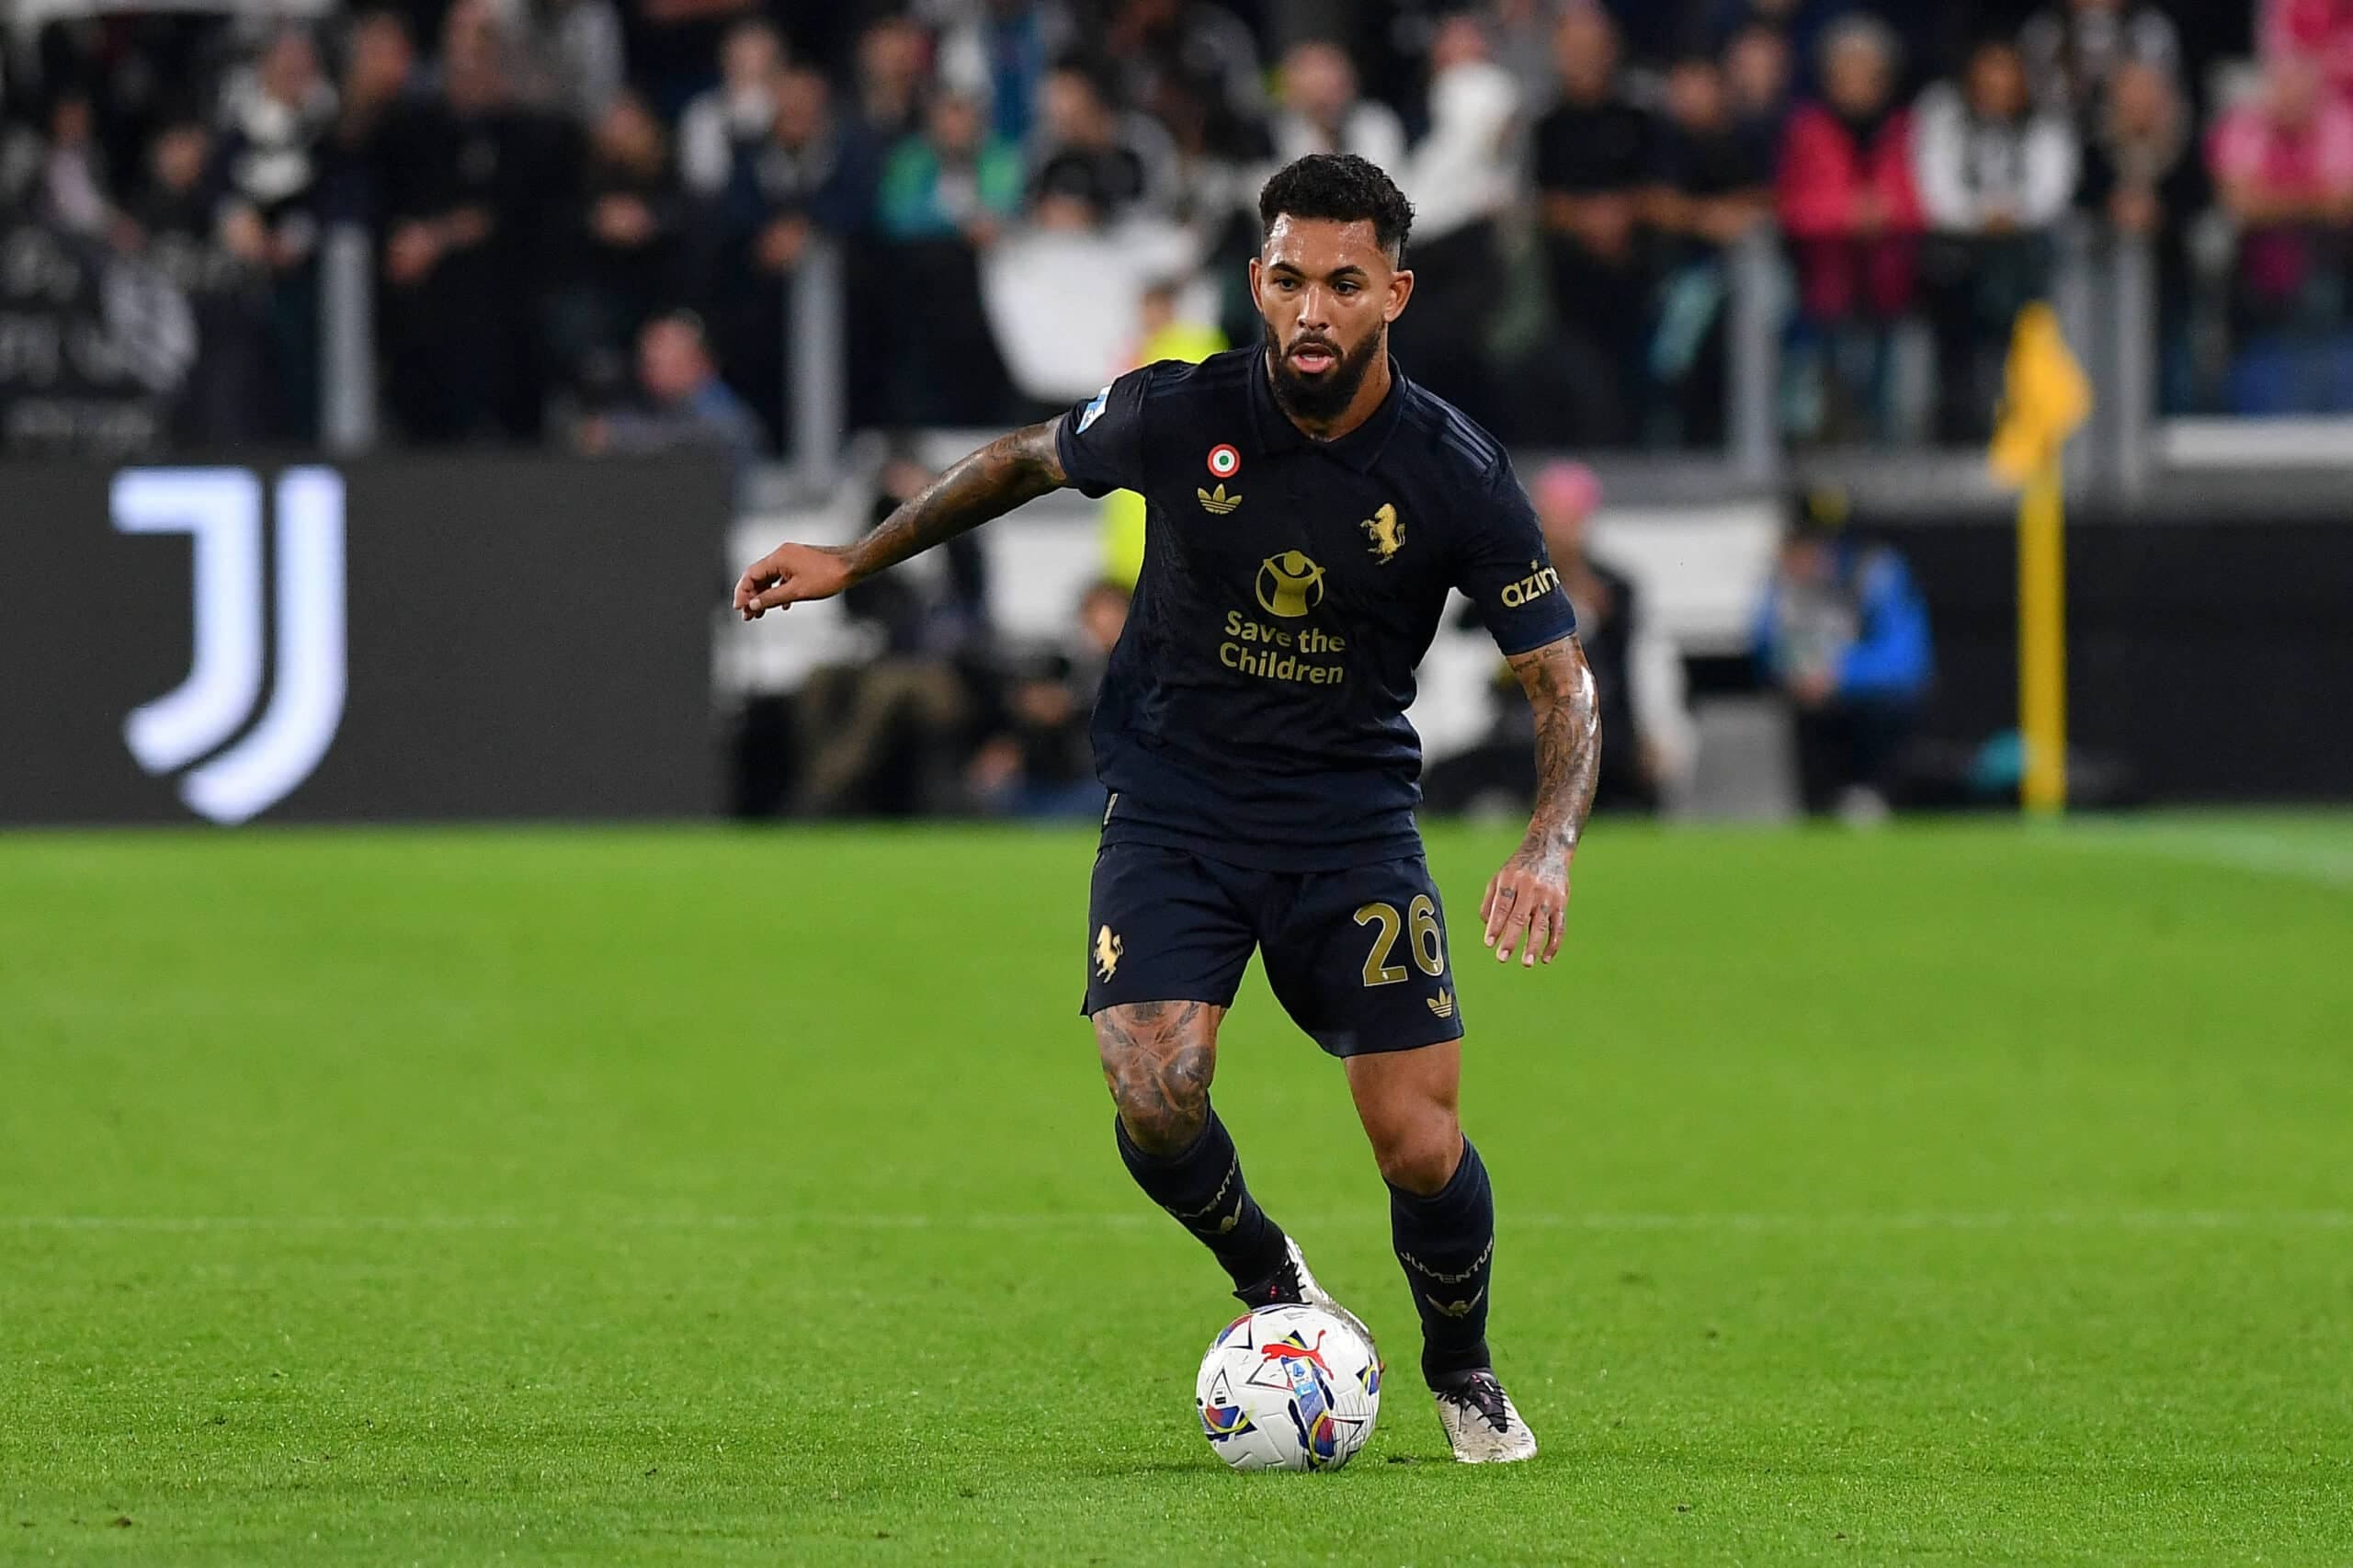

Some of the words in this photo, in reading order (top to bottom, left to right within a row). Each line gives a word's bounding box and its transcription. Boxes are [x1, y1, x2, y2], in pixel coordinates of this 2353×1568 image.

[1224, 609, 1292, 647] Save
[1298, 627, 1347, 653] the
[1220, 642, 1344, 684] Children
[1353, 893, 1444, 987] 26
